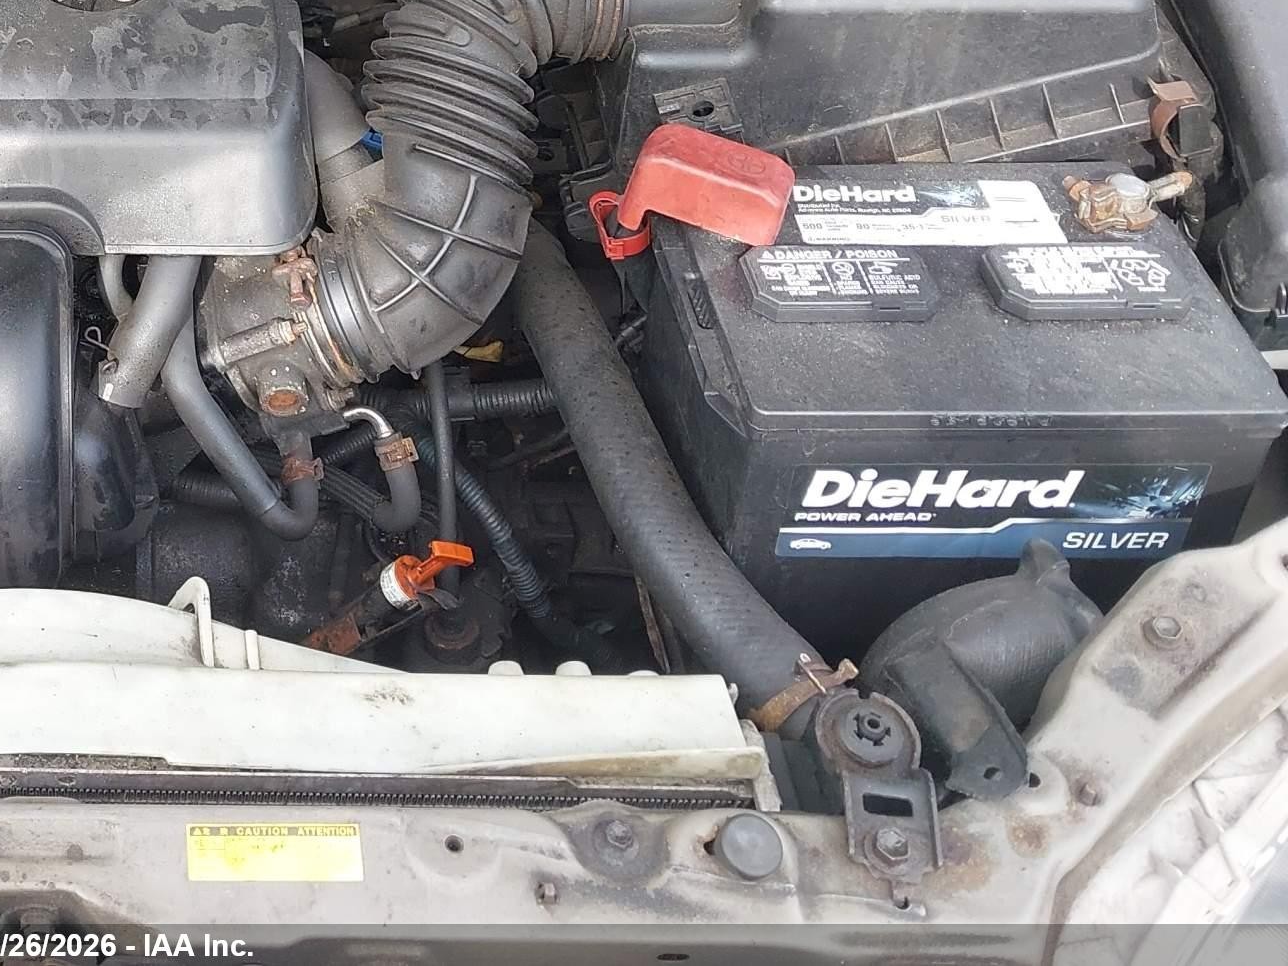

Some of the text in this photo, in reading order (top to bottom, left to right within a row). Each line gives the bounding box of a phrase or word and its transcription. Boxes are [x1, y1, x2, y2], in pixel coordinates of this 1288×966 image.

[793, 185, 917, 203] DieHard
[774, 250, 833, 260] DANGER
[846, 249, 899, 259] POISON
[801, 468, 1086, 509] DieHard
[794, 512, 932, 522] POWER AHEAD
[1063, 530, 1170, 550] SILVER
[236, 826, 355, 837] CAUTION ATTENTION
